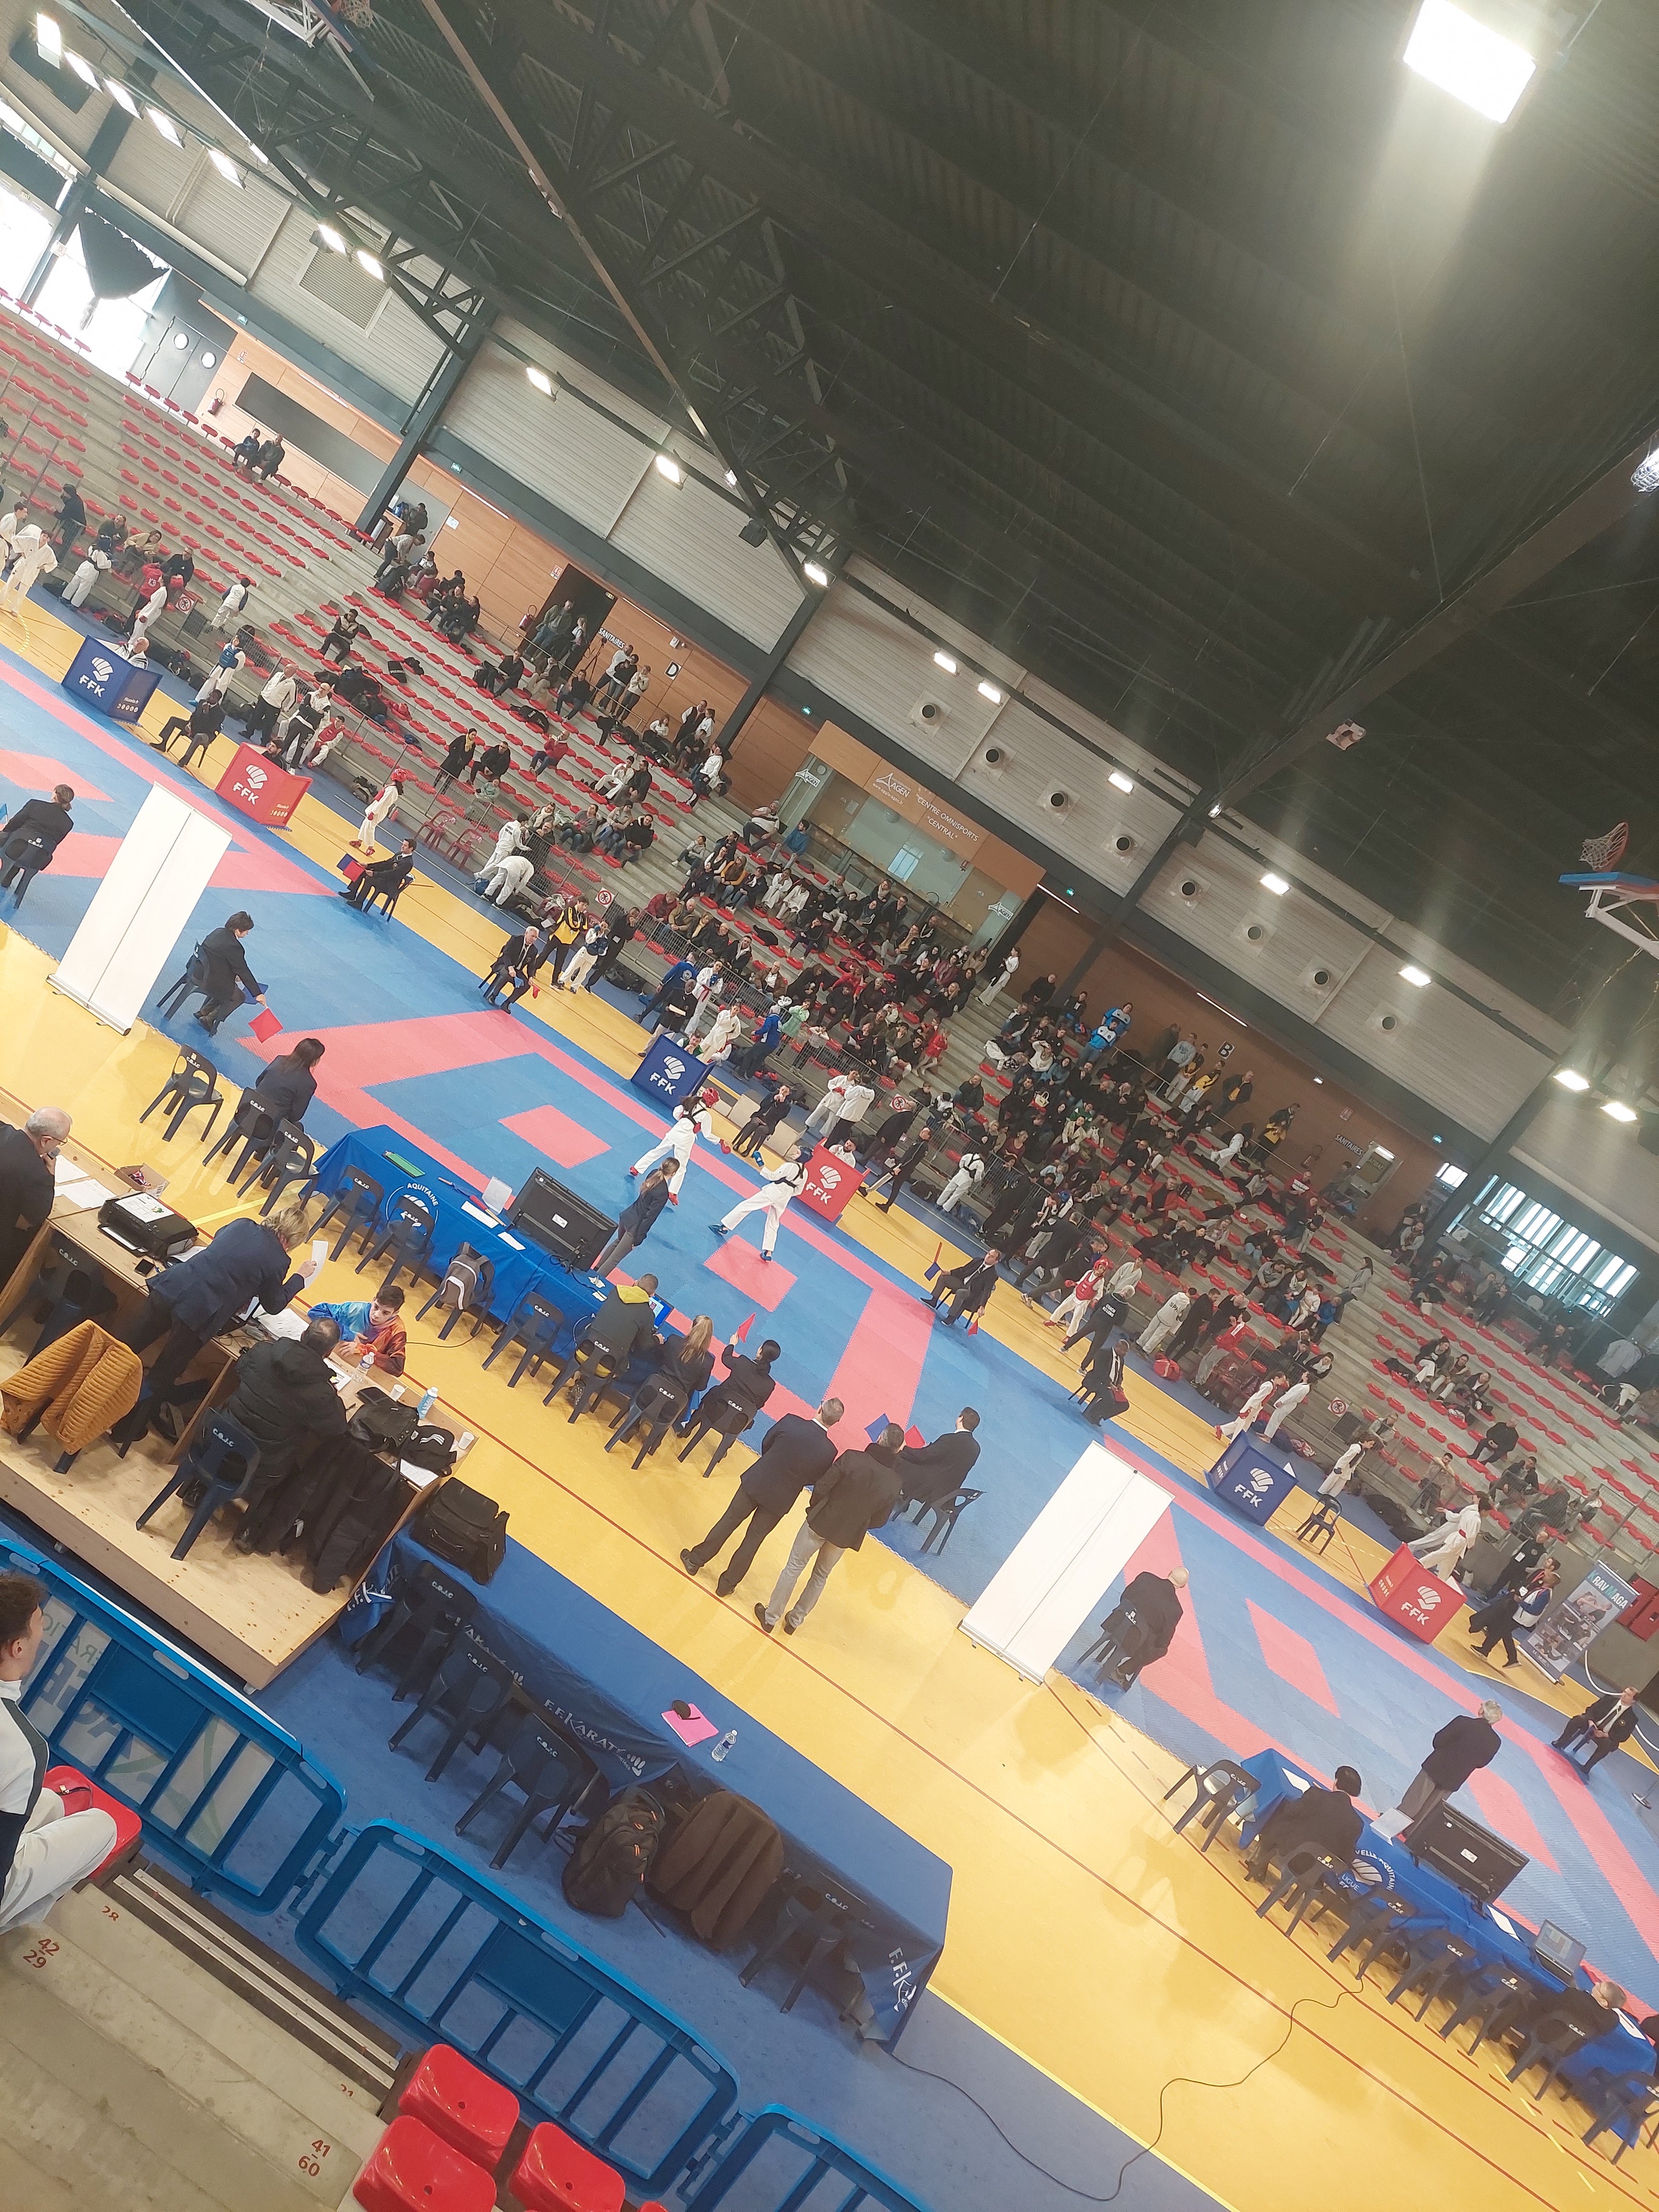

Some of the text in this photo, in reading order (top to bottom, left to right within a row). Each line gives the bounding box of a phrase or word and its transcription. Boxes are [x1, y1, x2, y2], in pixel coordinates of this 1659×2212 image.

[598, 628, 626, 649] SANITAIRES
[665, 662, 679, 677] D
[79, 675, 105, 697] FFK
[806, 775, 818, 786] AGEN
[890, 782, 910, 798] AGEN
[233, 781, 259, 805] FFK
[917, 796, 979, 842] CENTRE OMNISPORTS
[999, 909, 1011, 919] AGEN
[1218, 1042, 1233, 1058] B
[650, 1072, 676, 1095] FFK
[1335, 1134, 1363, 1156] SANITAIRES
[407, 1183, 439, 1206] AQUITAINE
[805, 1182, 832, 1206] FFK
[1234, 1483, 1264, 1508] FFK
[1401, 1601, 1431, 1626] FFK
[1342, 1873, 1360, 1892] LIGUE
[38, 1938, 60, 1957] 42
[22, 1949, 47, 1969] 29
[311, 2139, 331, 2157] 41
[298, 2155, 321, 2177] 60
